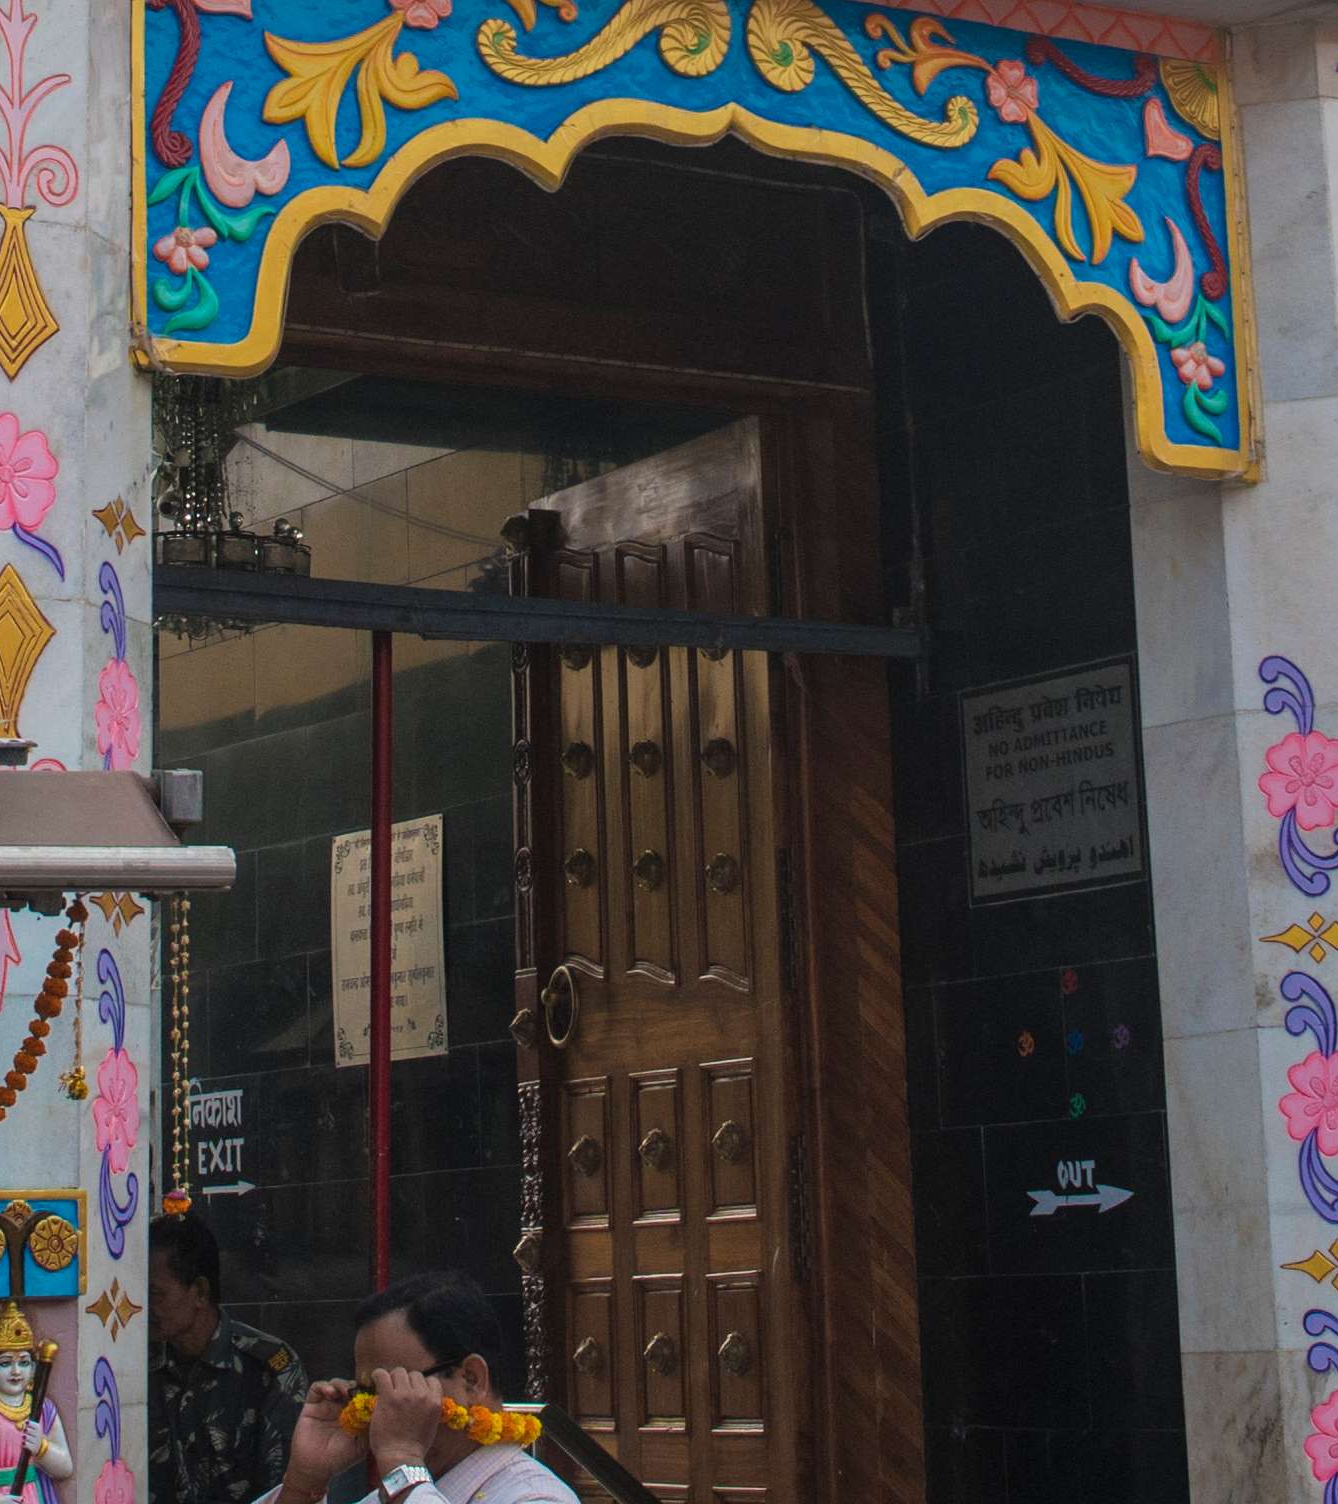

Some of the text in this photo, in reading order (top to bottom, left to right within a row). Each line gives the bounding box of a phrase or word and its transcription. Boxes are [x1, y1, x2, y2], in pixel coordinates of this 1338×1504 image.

[988, 720, 1108, 758] NO ADMITTANCE
[985, 742, 1115, 781] FOR NON-HINDUS
[197, 1137, 246, 1175] EXIT
[1056, 1160, 1096, 1189] OUT
